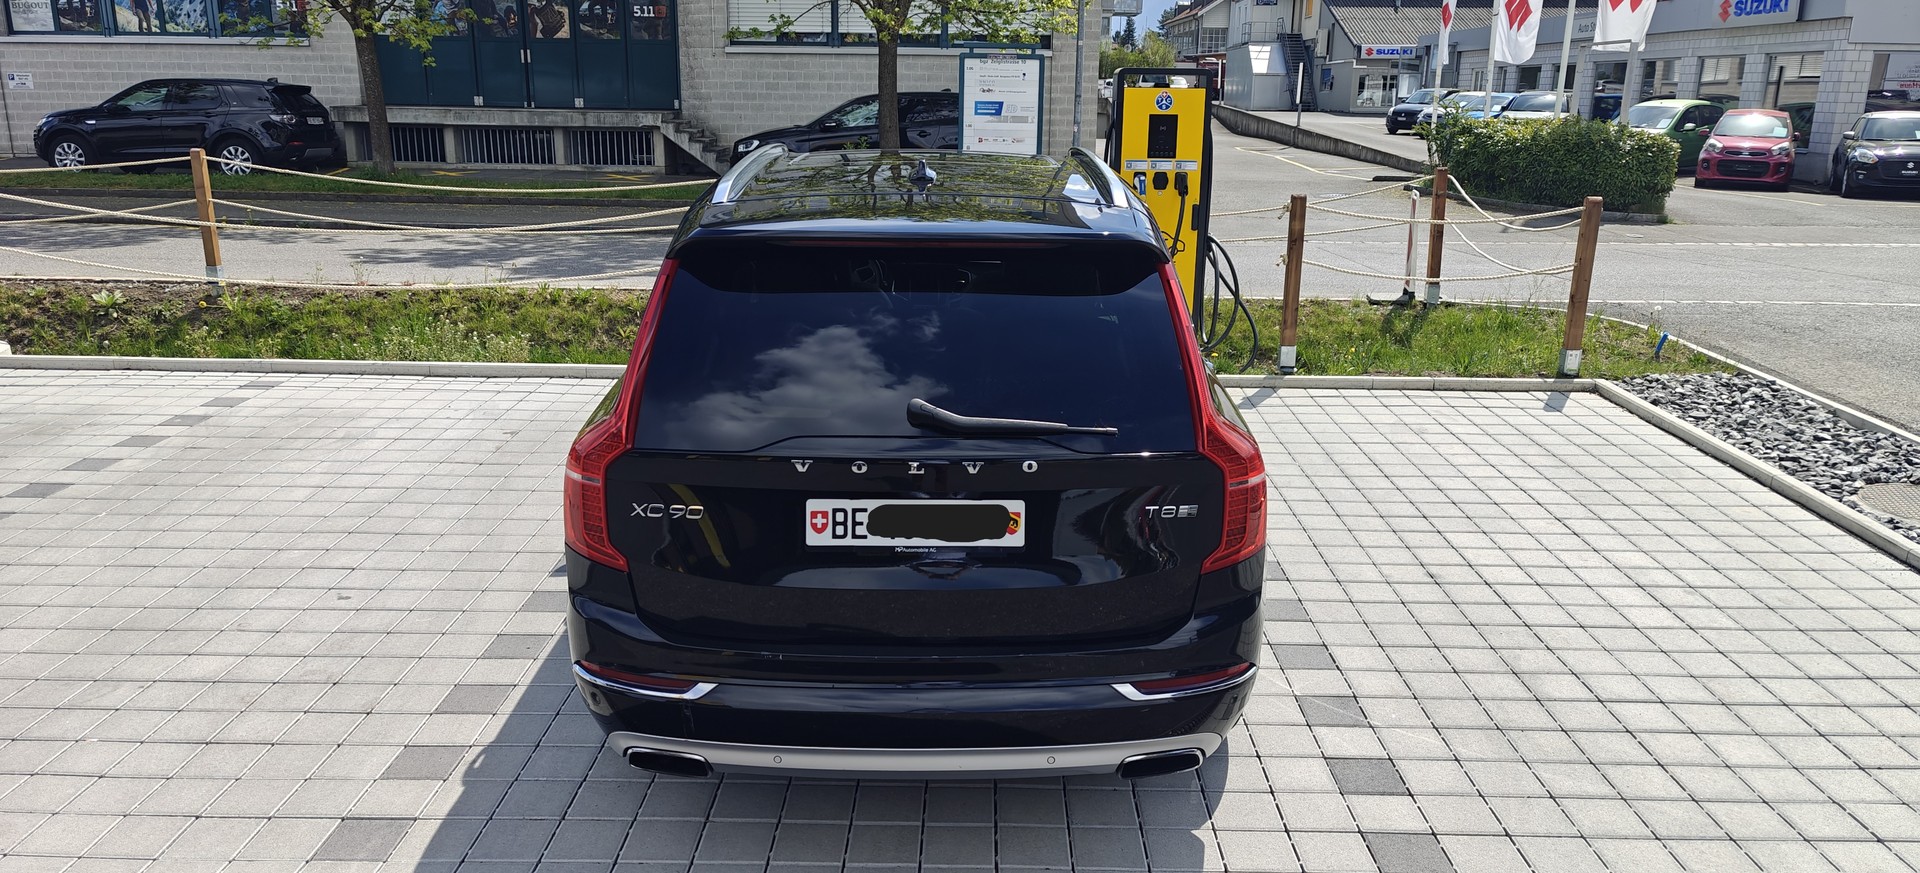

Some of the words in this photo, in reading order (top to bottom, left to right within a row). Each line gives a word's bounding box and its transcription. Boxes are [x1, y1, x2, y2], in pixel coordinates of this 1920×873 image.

[11, 1, 49, 9] BUGOUT
[1733, 0, 1788, 17] SUZUKI
[633, 5, 655, 17] 5.11
[1578, 23, 1590, 33] Auto
[1375, 48, 1413, 56] SUZUKI
[791, 459, 1040, 474] VOLVO
